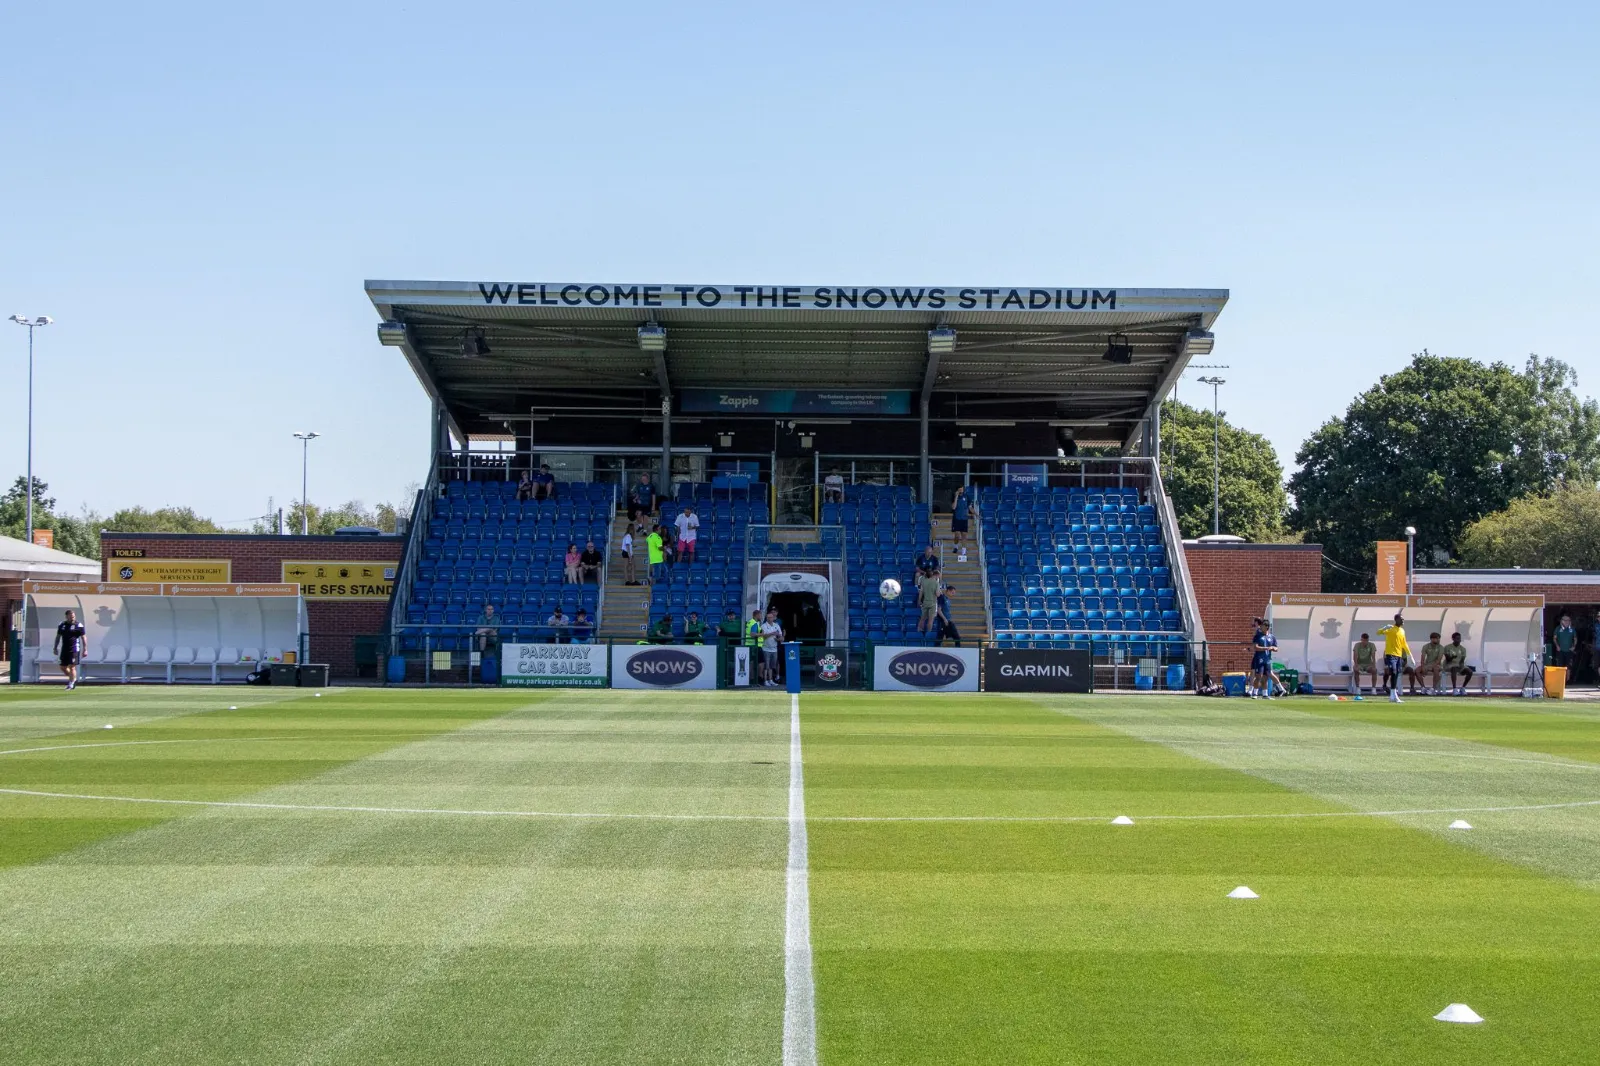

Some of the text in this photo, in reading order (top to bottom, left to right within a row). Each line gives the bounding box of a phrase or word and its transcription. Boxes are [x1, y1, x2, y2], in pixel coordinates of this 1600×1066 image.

[480, 284, 1116, 311] WELCOME TO THE SNOWS STADIUM
[719, 394, 759, 409] Zappie
[1011, 473, 1039, 484] Zappie
[115, 549, 142, 557] TOILETS
[120, 568, 133, 580] sfs
[300, 584, 316, 595] HE
[320, 584, 346, 595] SFS
[519, 645, 591, 659] PARKWAY
[517, 661, 592, 674] CAR SALES
[632, 660, 697, 674] SNOWS
[894, 662, 959, 676] SNOWS
[506, 678, 602, 686] www.parkwaycarsales.co.uk
